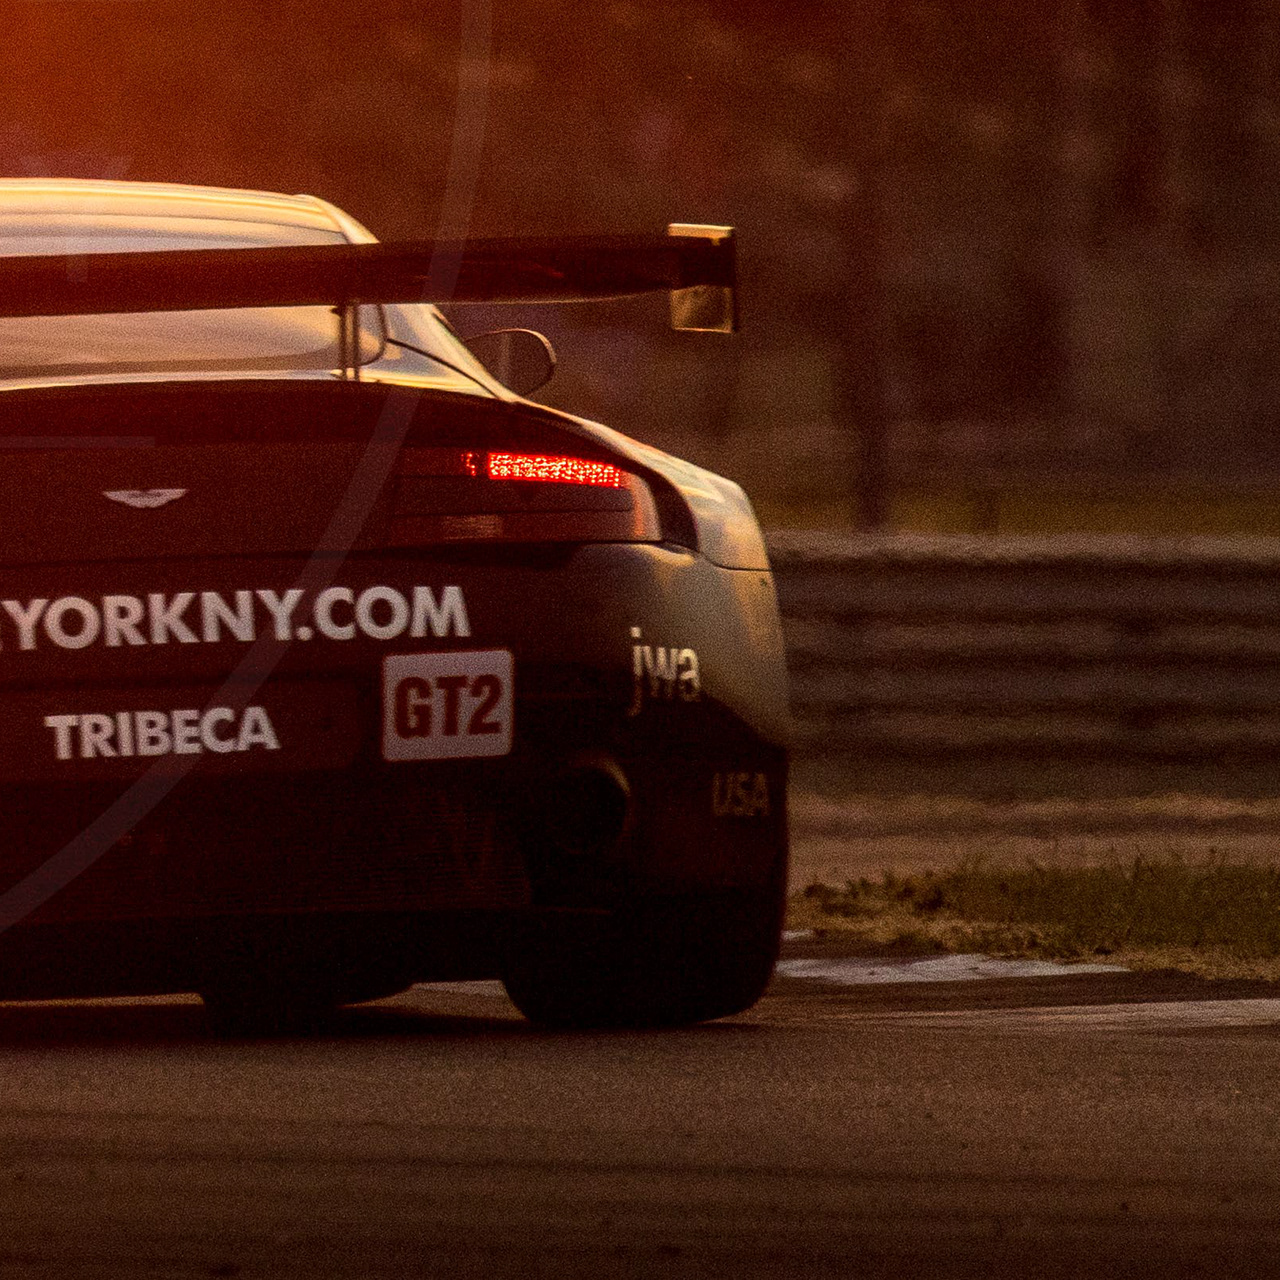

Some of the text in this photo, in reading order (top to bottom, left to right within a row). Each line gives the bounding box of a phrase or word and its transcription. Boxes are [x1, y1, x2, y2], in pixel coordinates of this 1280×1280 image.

[627, 626, 703, 718] jwa
[44, 705, 282, 762] TRIBECA
[391, 673, 505, 743] GT2
